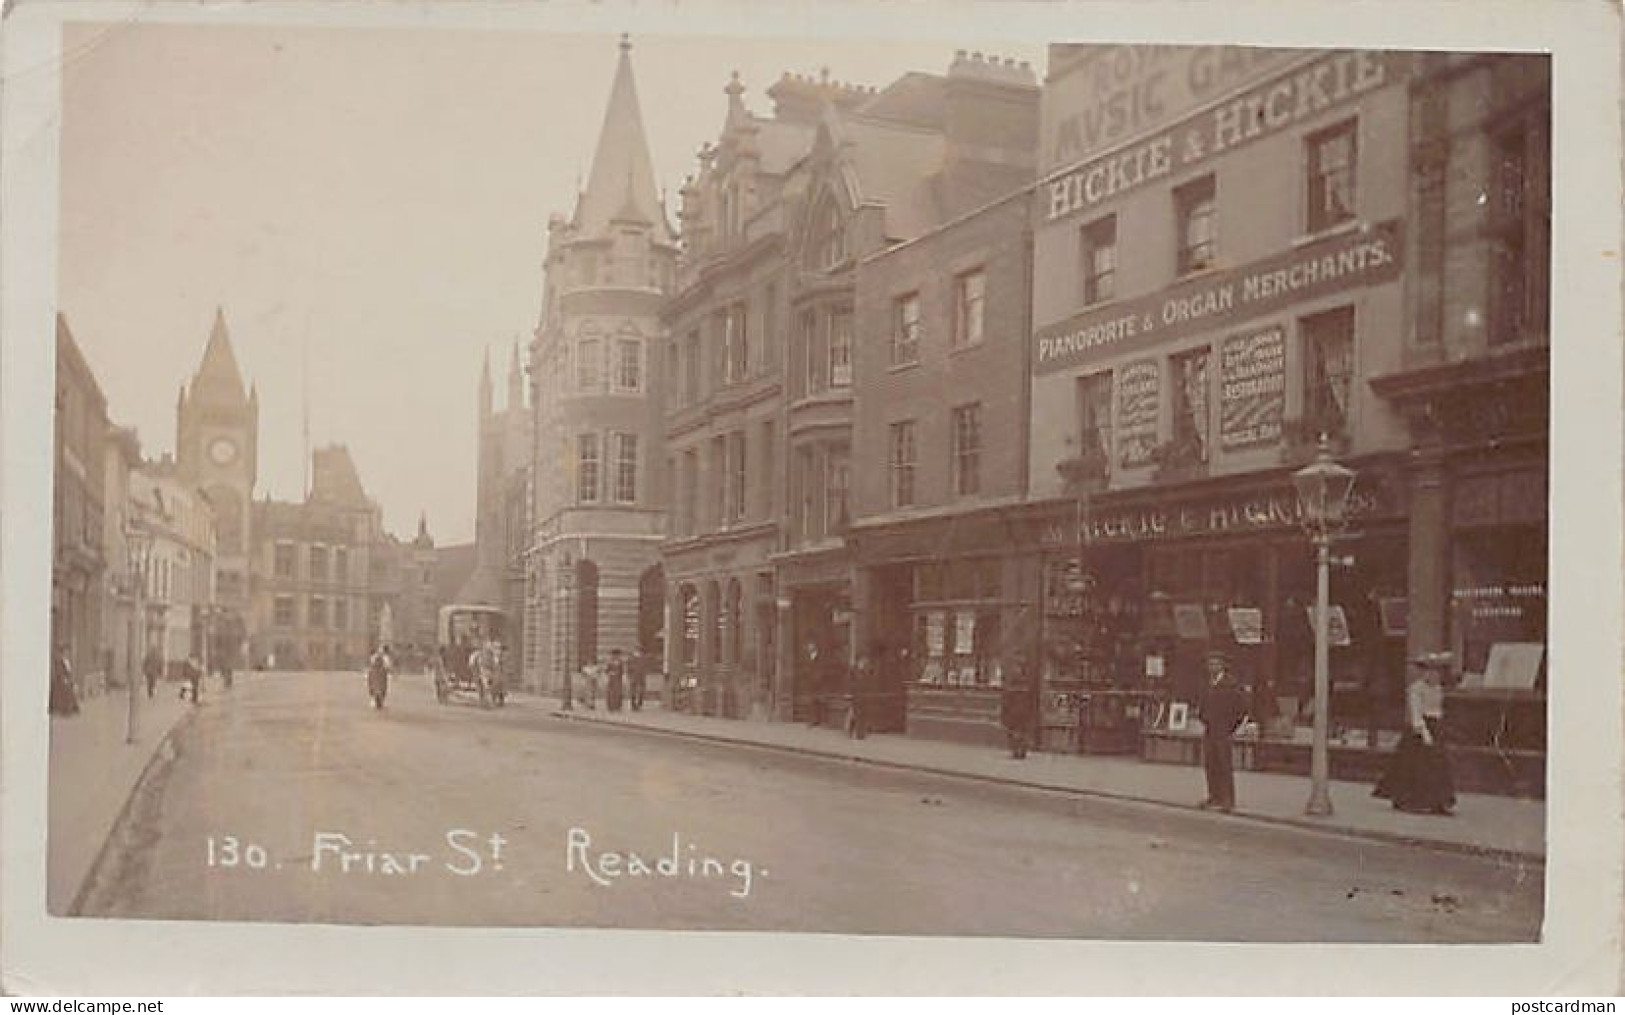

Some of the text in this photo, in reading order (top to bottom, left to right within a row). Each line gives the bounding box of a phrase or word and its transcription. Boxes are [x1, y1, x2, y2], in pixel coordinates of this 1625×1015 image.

[1049, 51, 1385, 220] HICKIE & HICKIE
[1057, 69, 1166, 160] MUSIC
[1039, 239, 1392, 362] PIANOFORTE & ORGAN MERCHANTS.
